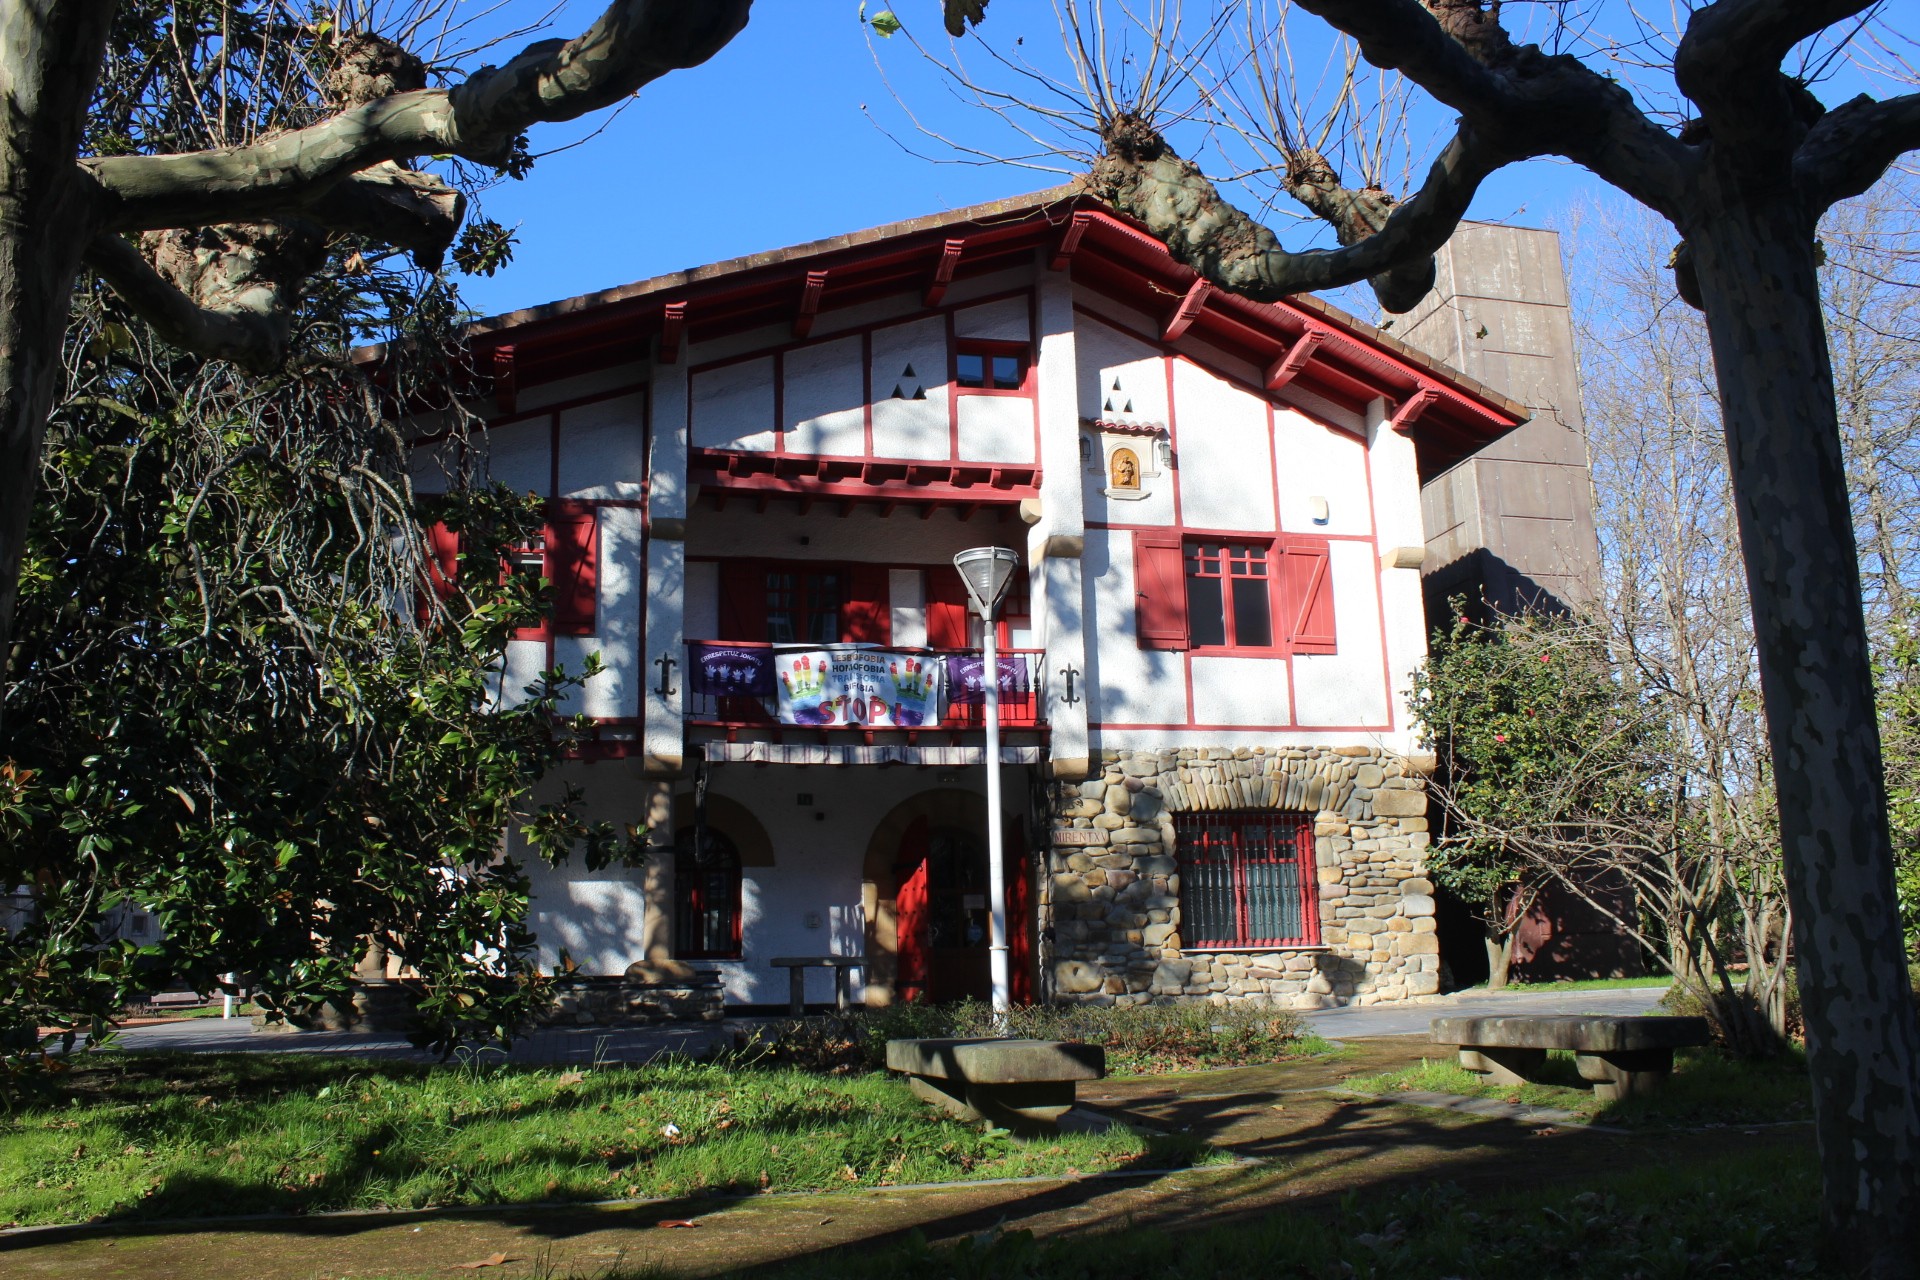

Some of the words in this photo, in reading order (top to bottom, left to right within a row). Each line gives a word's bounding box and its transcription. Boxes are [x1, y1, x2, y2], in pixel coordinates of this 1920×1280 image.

[700, 650, 739, 663] ERRESPETUZ
[740, 652, 763, 666] JOKATU
[832, 654, 886, 664] LESBOFOBIA
[832, 663, 885, 674] HOMOFOBIA
[832, 673, 886, 684] TRANSFOBIA
